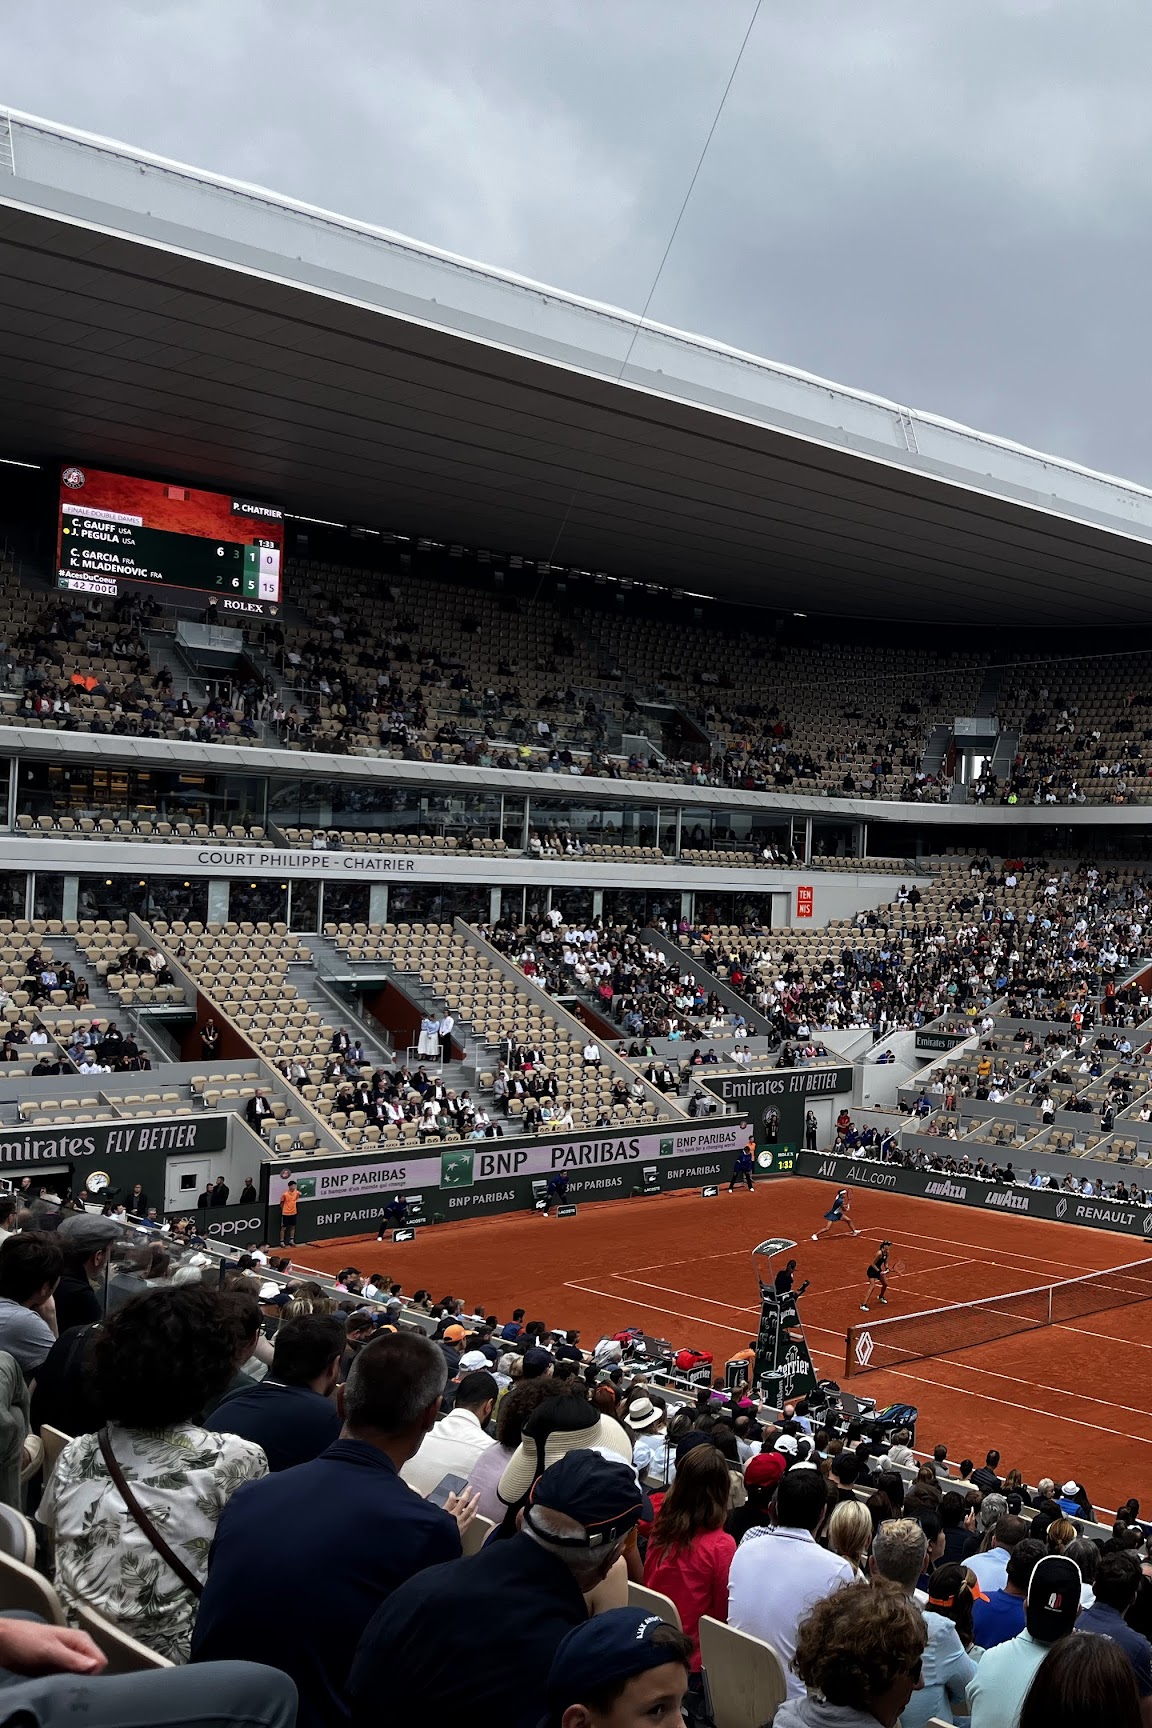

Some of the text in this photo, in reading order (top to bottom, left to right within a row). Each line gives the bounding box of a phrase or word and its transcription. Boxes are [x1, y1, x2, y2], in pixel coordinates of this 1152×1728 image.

[67, 506, 140, 524] FINALE DOUBLE DAMES
[233, 502, 283, 519] P. CHATRIER
[72, 518, 132, 535] C. GAUFF USA
[71, 528, 79, 536] J.
[81, 529, 119, 543] PEGULA
[258, 539, 275, 549] 1:33
[70, 548, 135, 565] C. GARCIA FRA
[217, 547, 273, 564] 6 3 1 0
[58, 569, 117, 585] #AcesDuCoeur
[70, 558, 163, 579] K. MLADENOVIC FRA
[73, 581, 86, 590] 42
[216, 575, 275, 593] 2 6 5 15
[223, 599, 264, 613] ROLEX
[198, 851, 255, 865] COURT
[260, 853, 329, 868] PHILIPPE
[343, 857, 415, 871] CHATRIER
[800, 890, 811, 900] TEN
[799, 904, 811, 914] NIS
[916, 1036, 945, 1048] Emirates
[722, 1072, 838, 1098] Emirates FLY BETTER
[0, 1125, 197, 1162] mirates FLY BETTER
[677, 1131, 737, 1148] BNP PARIBAS
[479, 1139, 640, 1177] BNP PARIBAS
[321, 1168, 406, 1189] BNP PARIBAS
[667, 1164, 721, 1179] BNP PARIBAS
[846, 1166, 897, 1187] ALL.com
[565, 1177, 623, 1193] BNP PARIBAS
[924, 1180, 967, 1200] LAVAZZA
[449, 1190, 515, 1208] BNP PARIBAS
[984, 1190, 1030, 1211] LAVAZZA
[316, 1207, 385, 1226] BNP PARIBA
[1075, 1205, 1136, 1225] RENAULT
[208, 1218, 261, 1236] oppo
